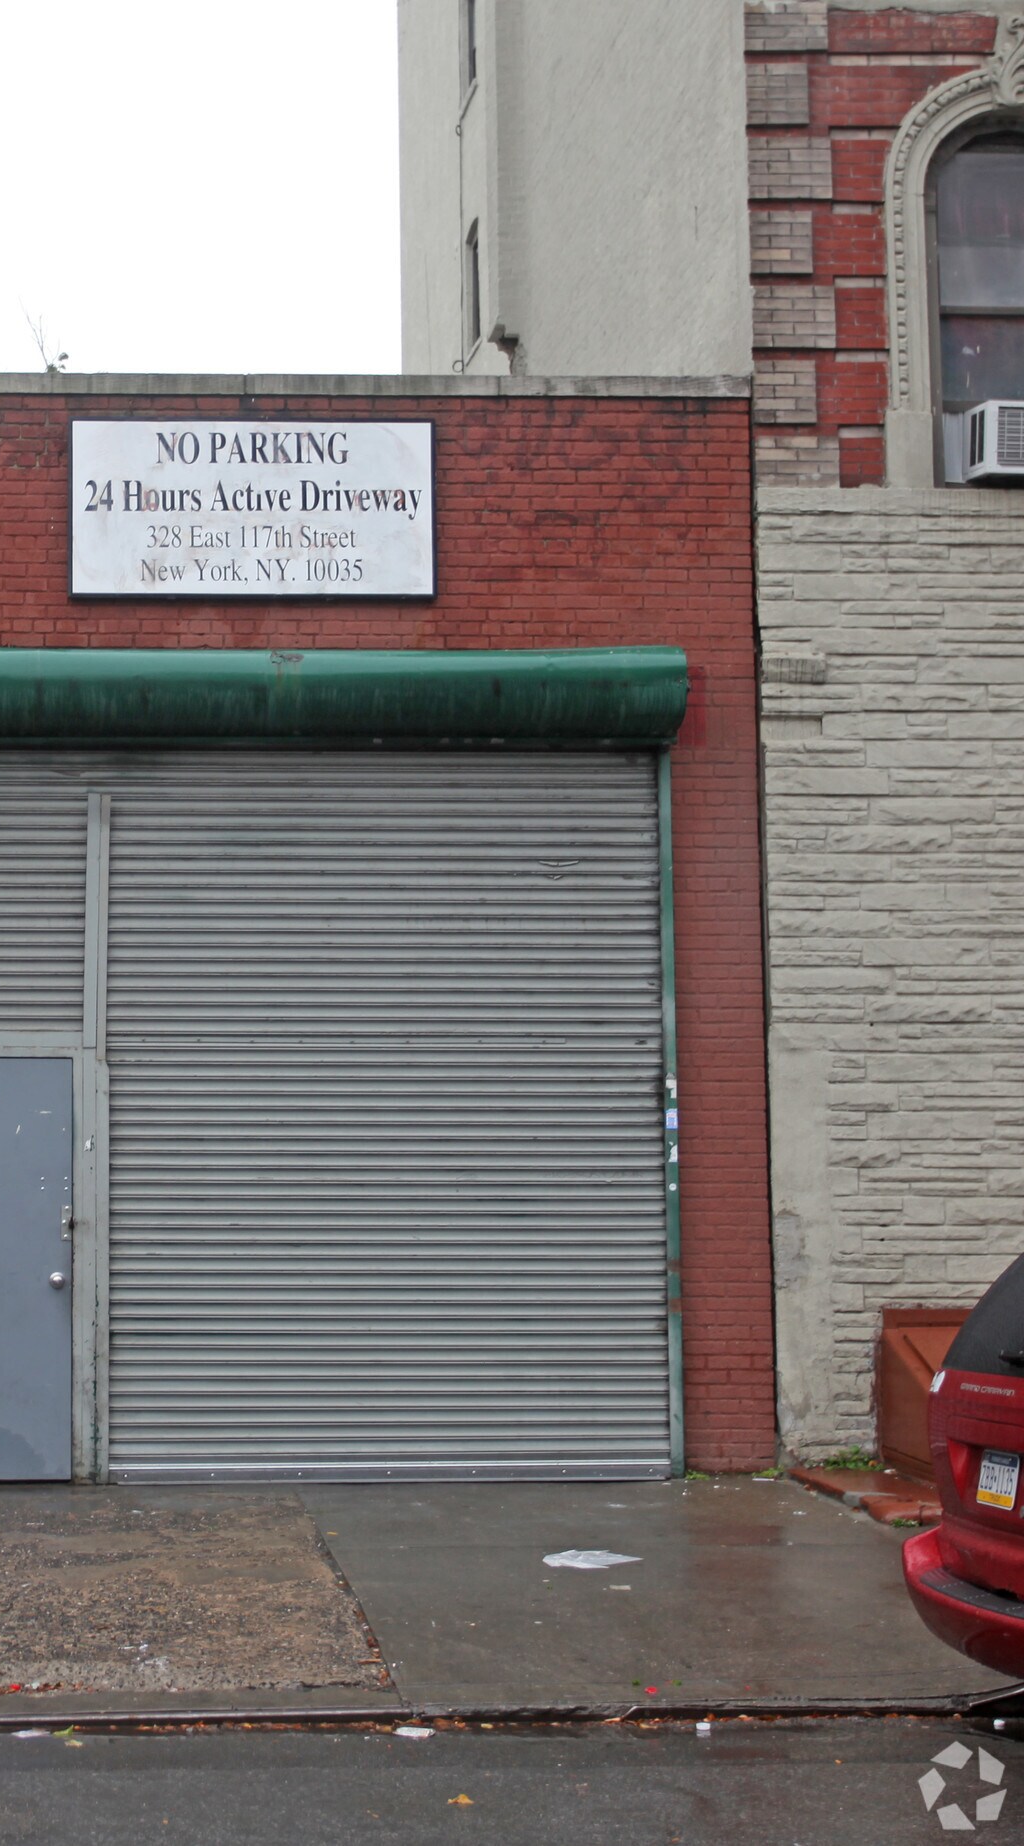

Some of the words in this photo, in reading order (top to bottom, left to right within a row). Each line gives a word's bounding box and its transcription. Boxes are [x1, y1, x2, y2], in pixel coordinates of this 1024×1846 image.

[156, 431, 201, 465] NO
[208, 431, 349, 465] PARKING
[84, 480, 114, 512] 24
[122, 480, 202, 512] Hours
[211, 480, 291, 512] Active
[299, 479, 423, 520] Driveway
[146, 525, 182, 548] 328
[189, 525, 231, 548] East
[239, 525, 292, 549] 117th
[299, 525, 357, 549] Street
[140, 559, 185, 582] New
[193, 559, 249, 585] York,
[255, 559, 296, 582] NY.
[305, 559, 363, 583] 10035
